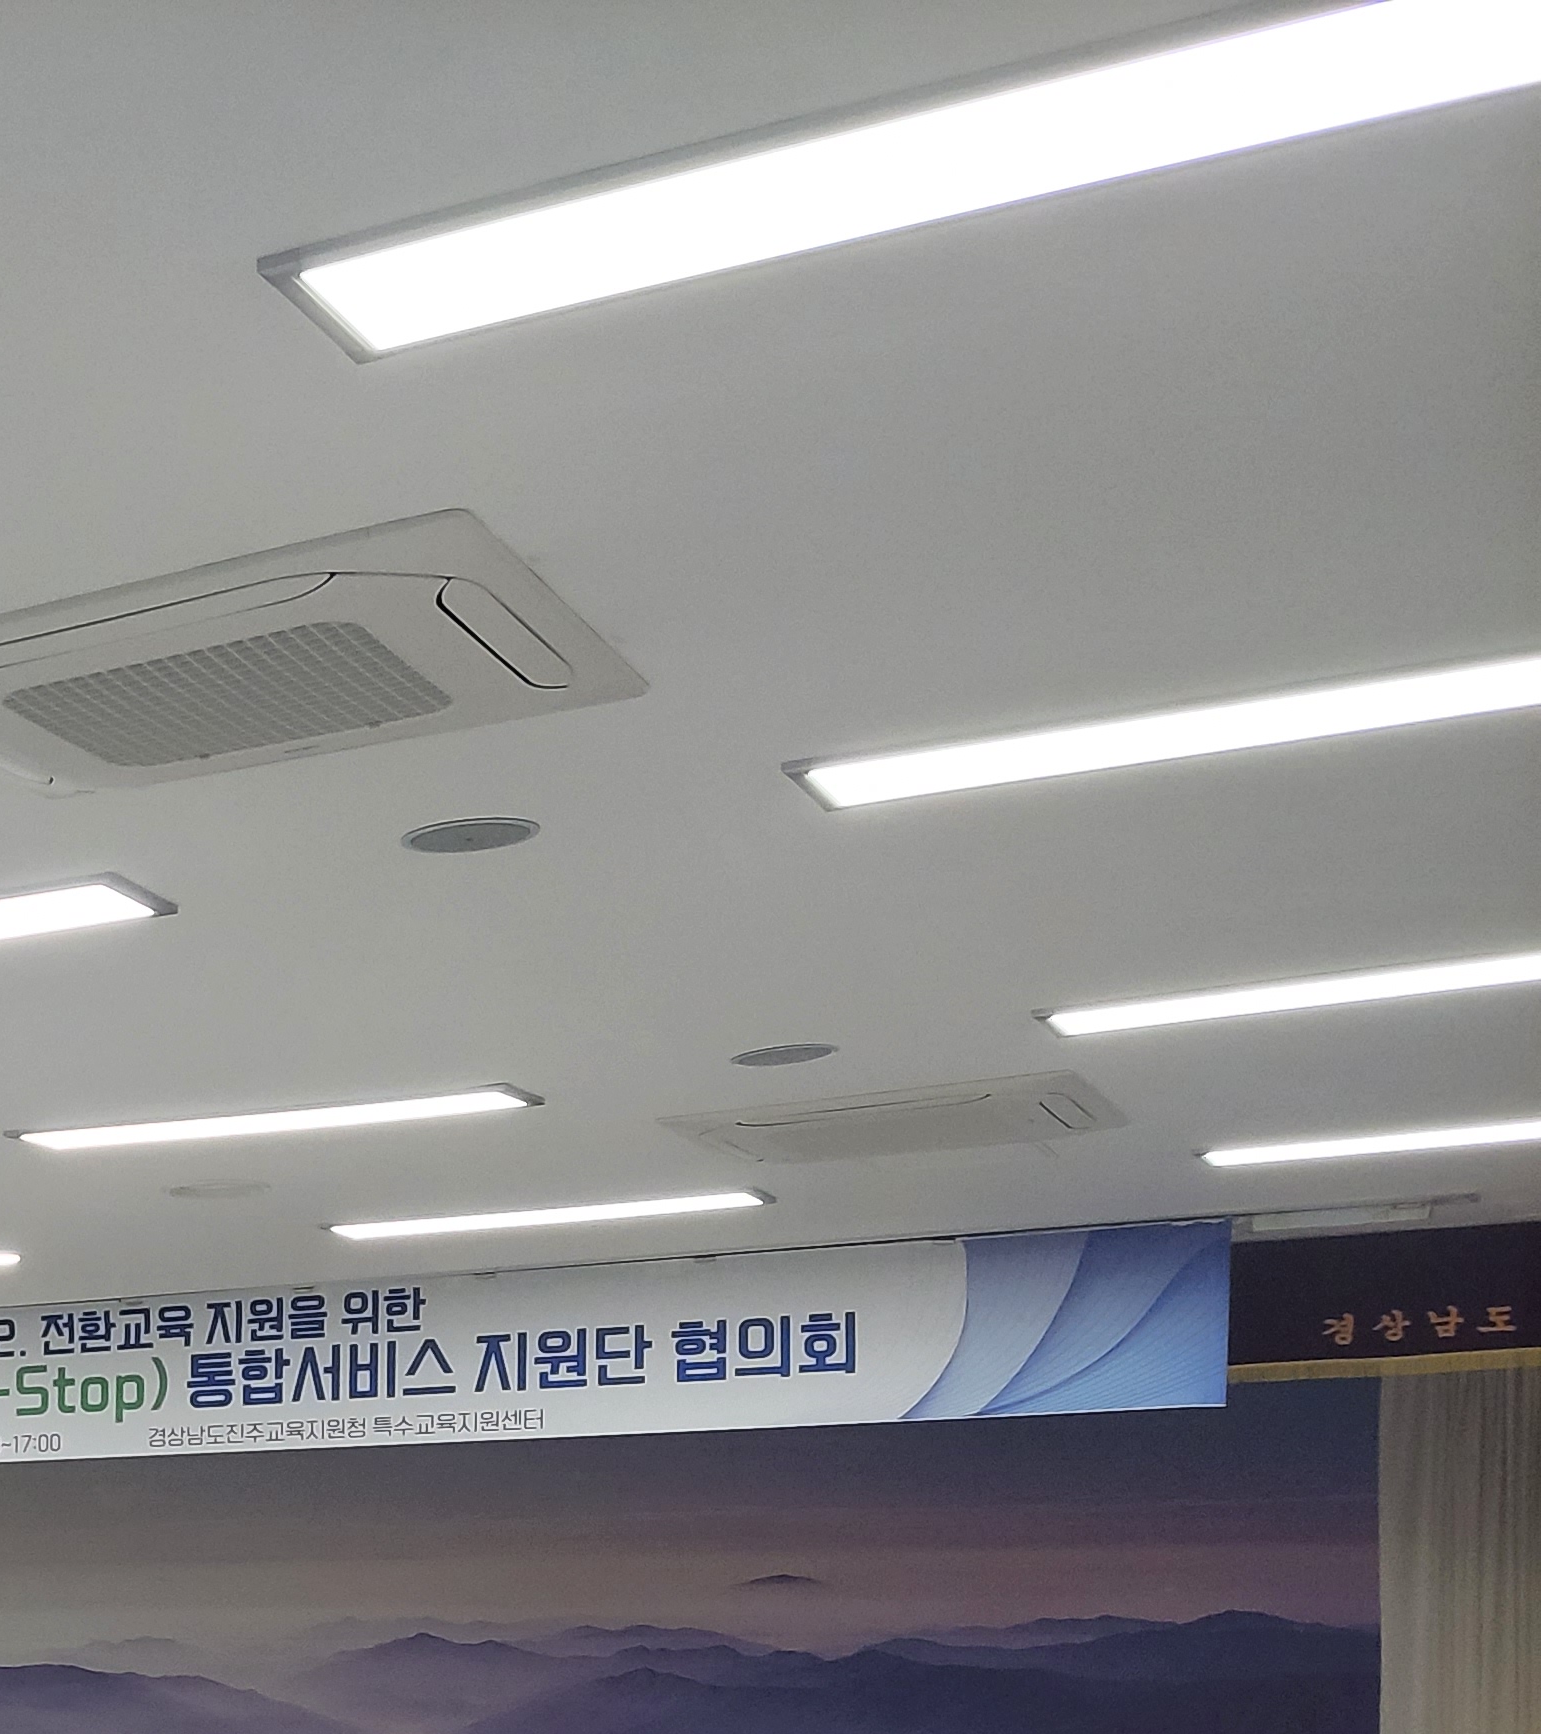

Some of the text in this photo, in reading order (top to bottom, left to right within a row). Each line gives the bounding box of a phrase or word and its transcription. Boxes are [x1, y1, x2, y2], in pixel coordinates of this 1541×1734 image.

[40, 1304, 195, 1356] 전환교육
[205, 1294, 328, 1345] 지원을
[341, 1286, 427, 1335] 위한
[1321, 1304, 1517, 1346] 경상남도
[186, 1338, 457, 1409] 통합서비스
[473, 1323, 653, 1393] 지원단
[670, 1310, 857, 1383] 협의회
[148, 1408, 545, 1448] 경상남도진주교육지원청 특수교육지원센터
